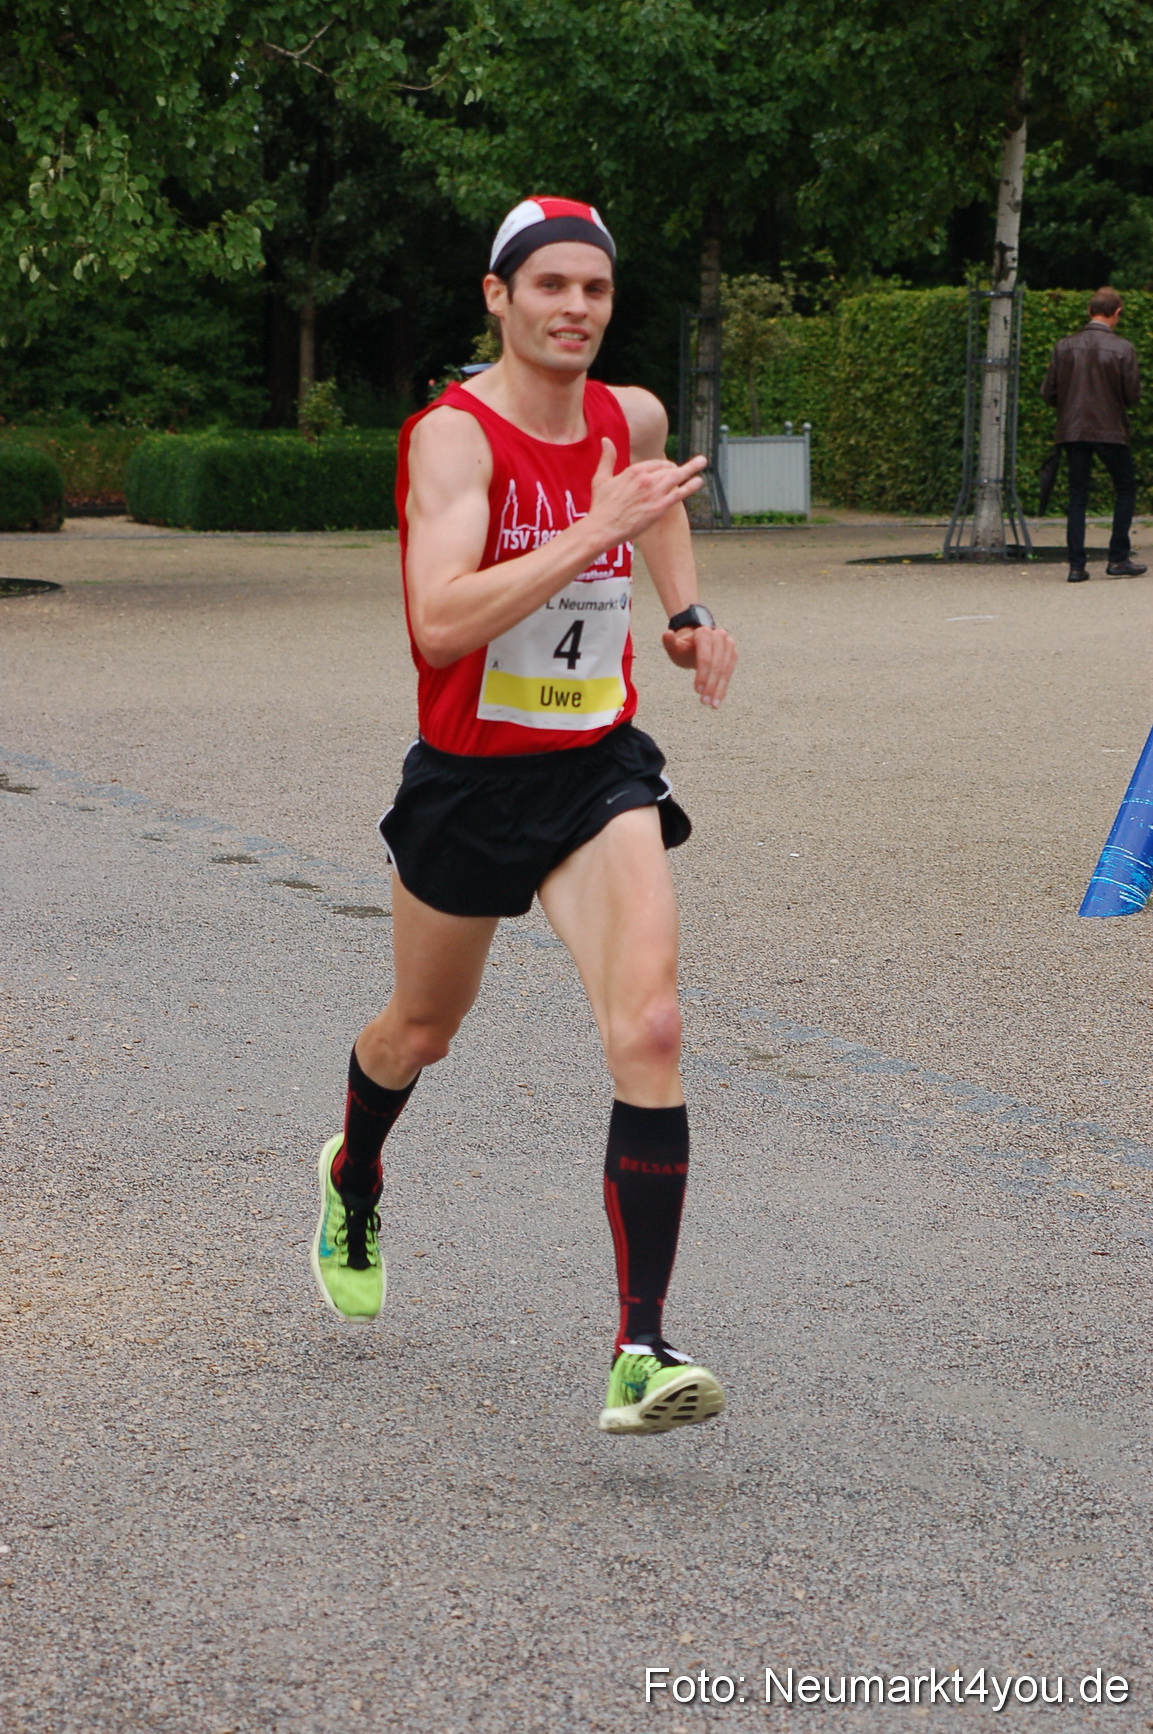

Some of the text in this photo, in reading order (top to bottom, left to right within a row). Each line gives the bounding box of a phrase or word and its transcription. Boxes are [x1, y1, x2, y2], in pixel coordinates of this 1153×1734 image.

[503, 529, 531, 550] TSV
[553, 620, 585, 670] 4
[540, 685, 582, 708] Uwe
